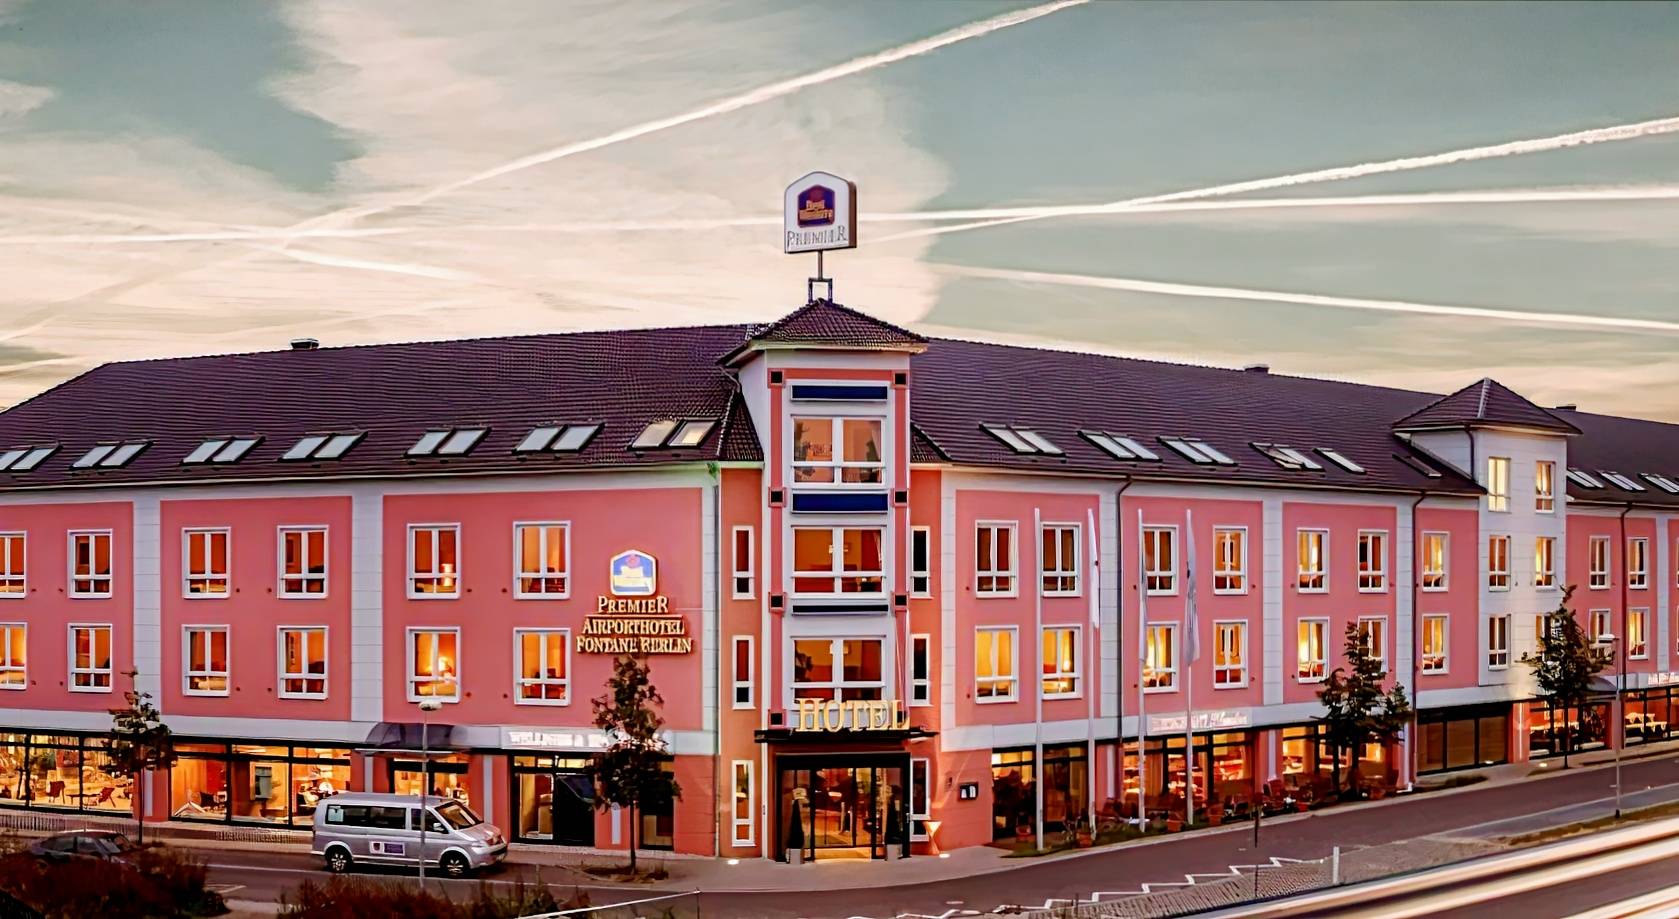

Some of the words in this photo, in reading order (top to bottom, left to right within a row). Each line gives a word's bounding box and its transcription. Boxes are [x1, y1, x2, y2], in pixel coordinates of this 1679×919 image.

[597, 595, 669, 613] PREMIER
[582, 618, 685, 635] AIRPORTHOTEL
[576, 635, 638, 653] FONTANE
[795, 697, 911, 733] HOTEL
